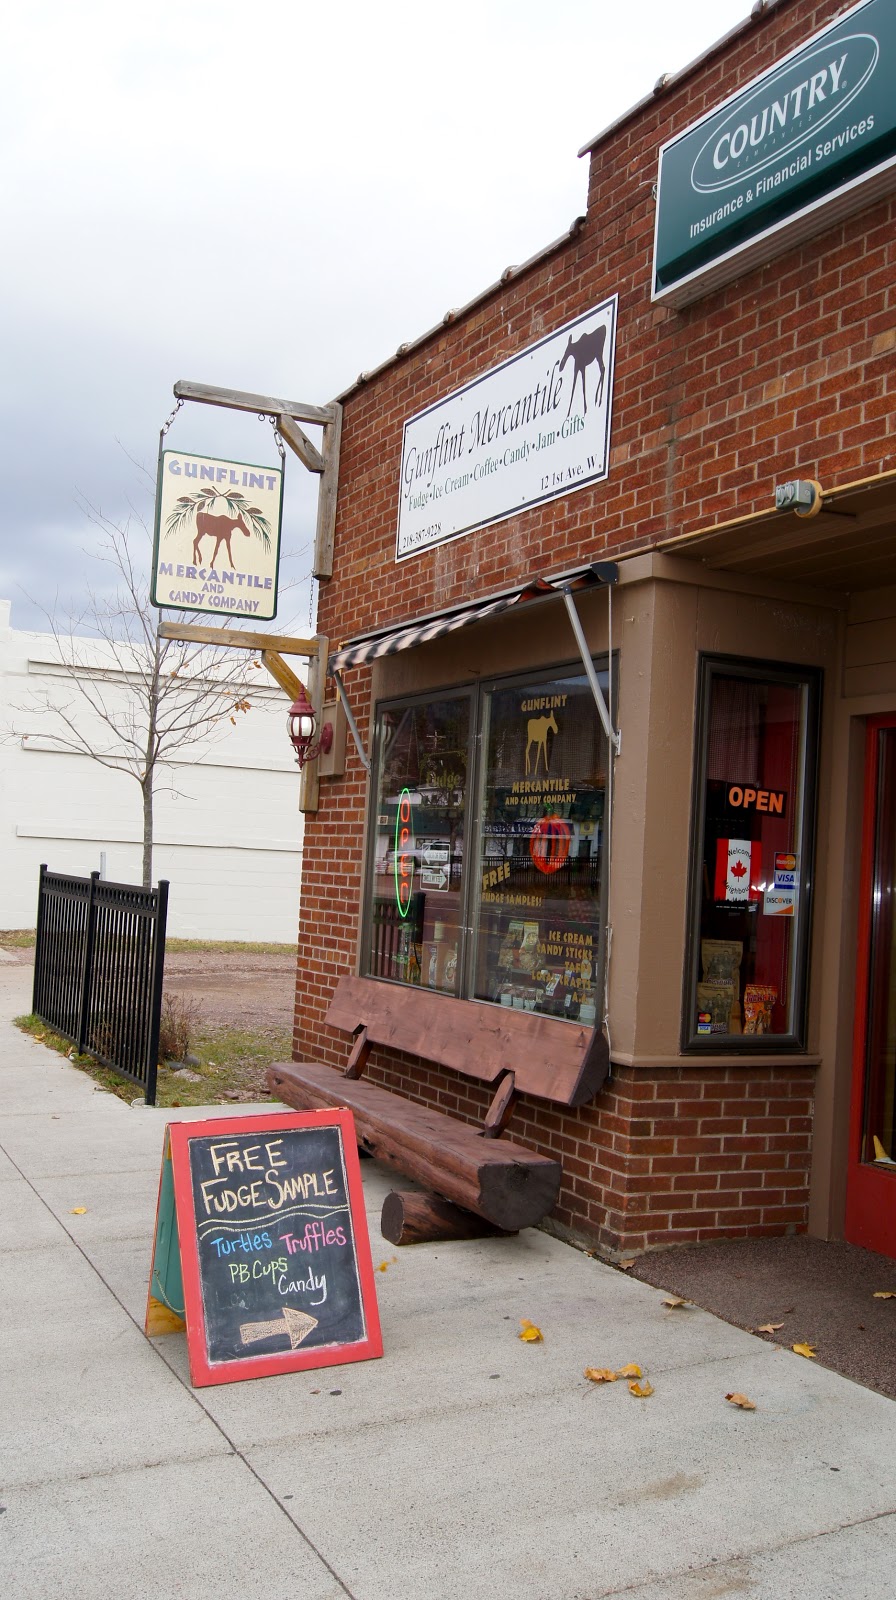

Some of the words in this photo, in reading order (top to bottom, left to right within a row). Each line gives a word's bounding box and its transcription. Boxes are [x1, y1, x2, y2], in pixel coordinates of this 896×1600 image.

[713, 53, 848, 169] COUNTRY
[690, 196, 743, 239] Insurance
[745, 189, 753, 204] &
[756, 149, 812, 197] Financial
[815, 114, 874, 161] Services
[404, 422, 465, 499] Gunflint
[468, 360, 562, 454] Mercantile
[168, 459, 277, 491] GUNFLINT
[541, 475, 549, 490] 12
[551, 470, 563, 486] 1st
[565, 464, 584, 480] Ave.
[402, 522, 442, 549] 218-387-9228
[159, 562, 273, 590] MERCANTILE
[201, 582, 225, 594] AND
[168, 590, 205, 605] CANDY
[208, 596, 260, 613] COMPANY
[521, 694, 568, 712] GUNFLINT
[512, 778, 570, 793] MERCANTILE
[505, 796, 519, 806] AND
[520, 795, 541, 805] CANDY
[543, 793, 577, 804] COMPANY
[728, 786, 784, 814] OPEN
[728, 847, 752, 860] Welcome
[482, 861, 510, 891] FREE
[777, 874, 795, 883] VISA
[481, 891, 505, 904] FUDGE
[766, 896, 793, 905] DISCOVER
[548, 930, 561, 942] ICE
[563, 932, 593, 946] CREAM
[536, 943, 563, 956] CANDY
[566, 946, 593, 961] STICKS
[210, 1139, 288, 1177] FREE
[200, 1177, 267, 1215] FUDGE
[265, 1168, 339, 1210] SAMPLE
[210, 1231, 273, 1258] Turtles
[279, 1221, 347, 1255] Truffles
[278, 1266, 327, 1306] Candy
